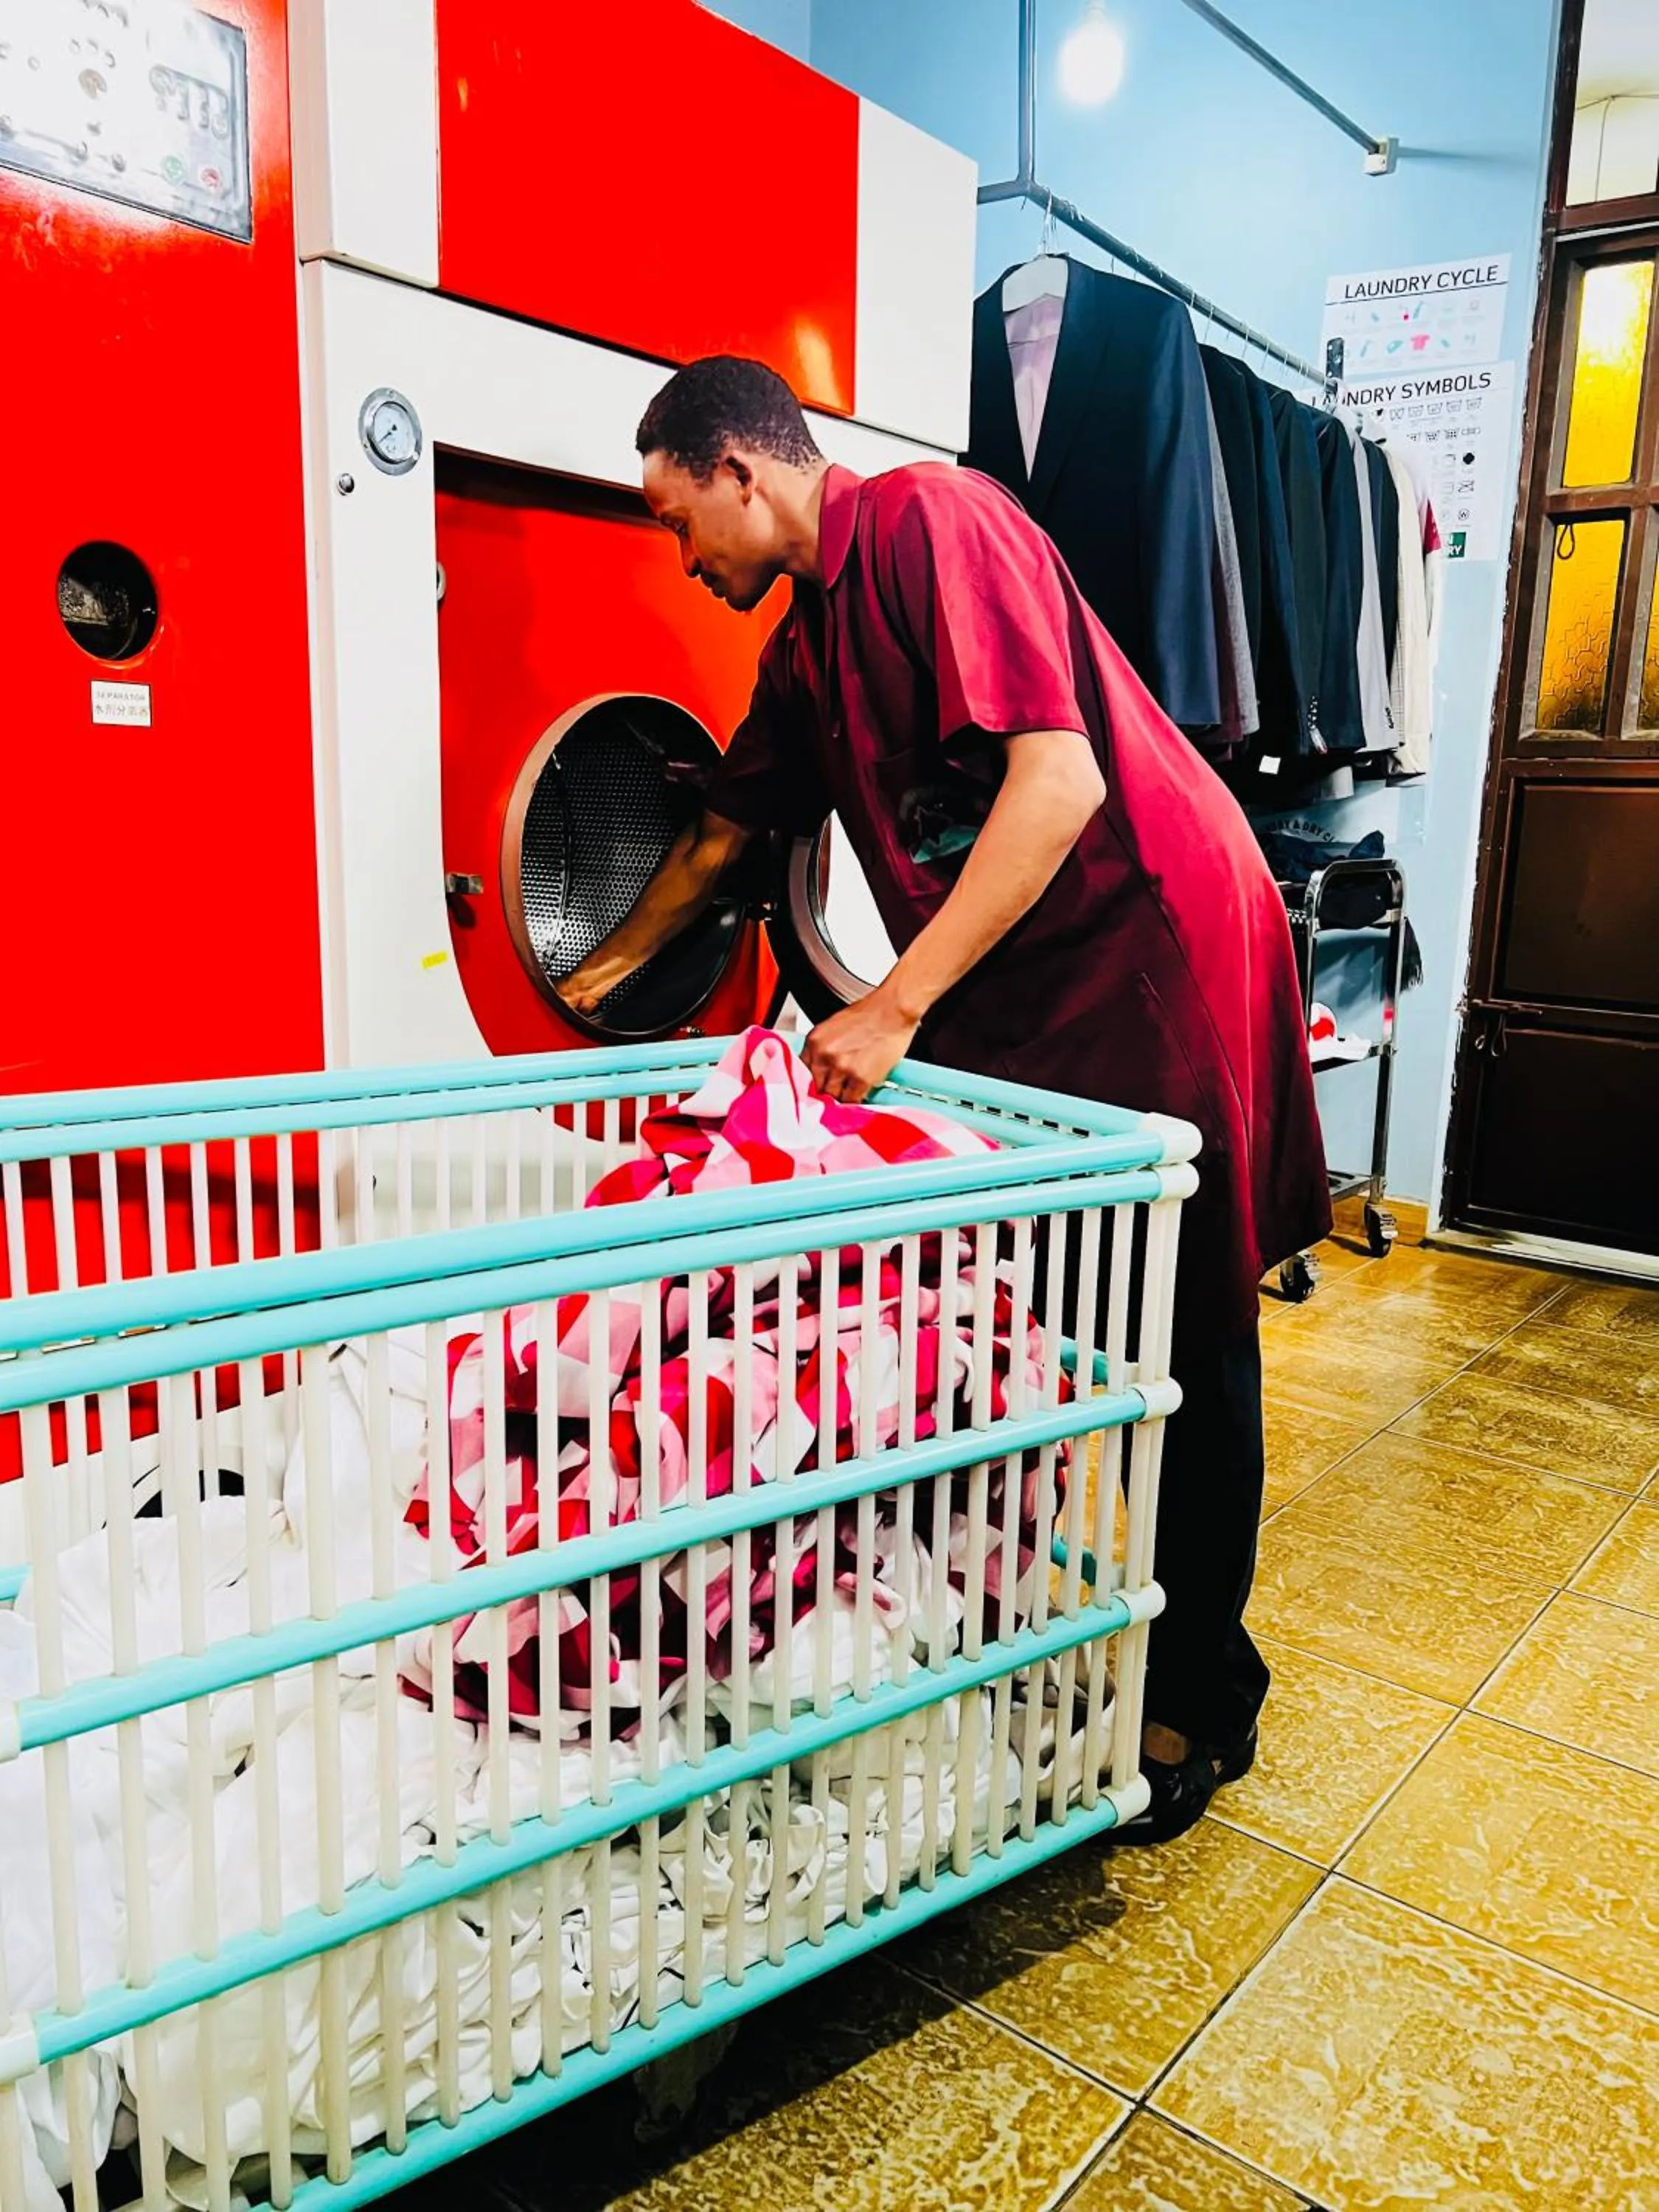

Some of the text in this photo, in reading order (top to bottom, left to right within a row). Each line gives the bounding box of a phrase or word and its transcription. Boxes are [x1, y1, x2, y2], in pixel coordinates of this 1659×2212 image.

[1344, 265, 1499, 299] LAUNDRY CYCLE
[1401, 372, 1492, 400] SYMBOLS
[1302, 821, 1325, 837] DRY
